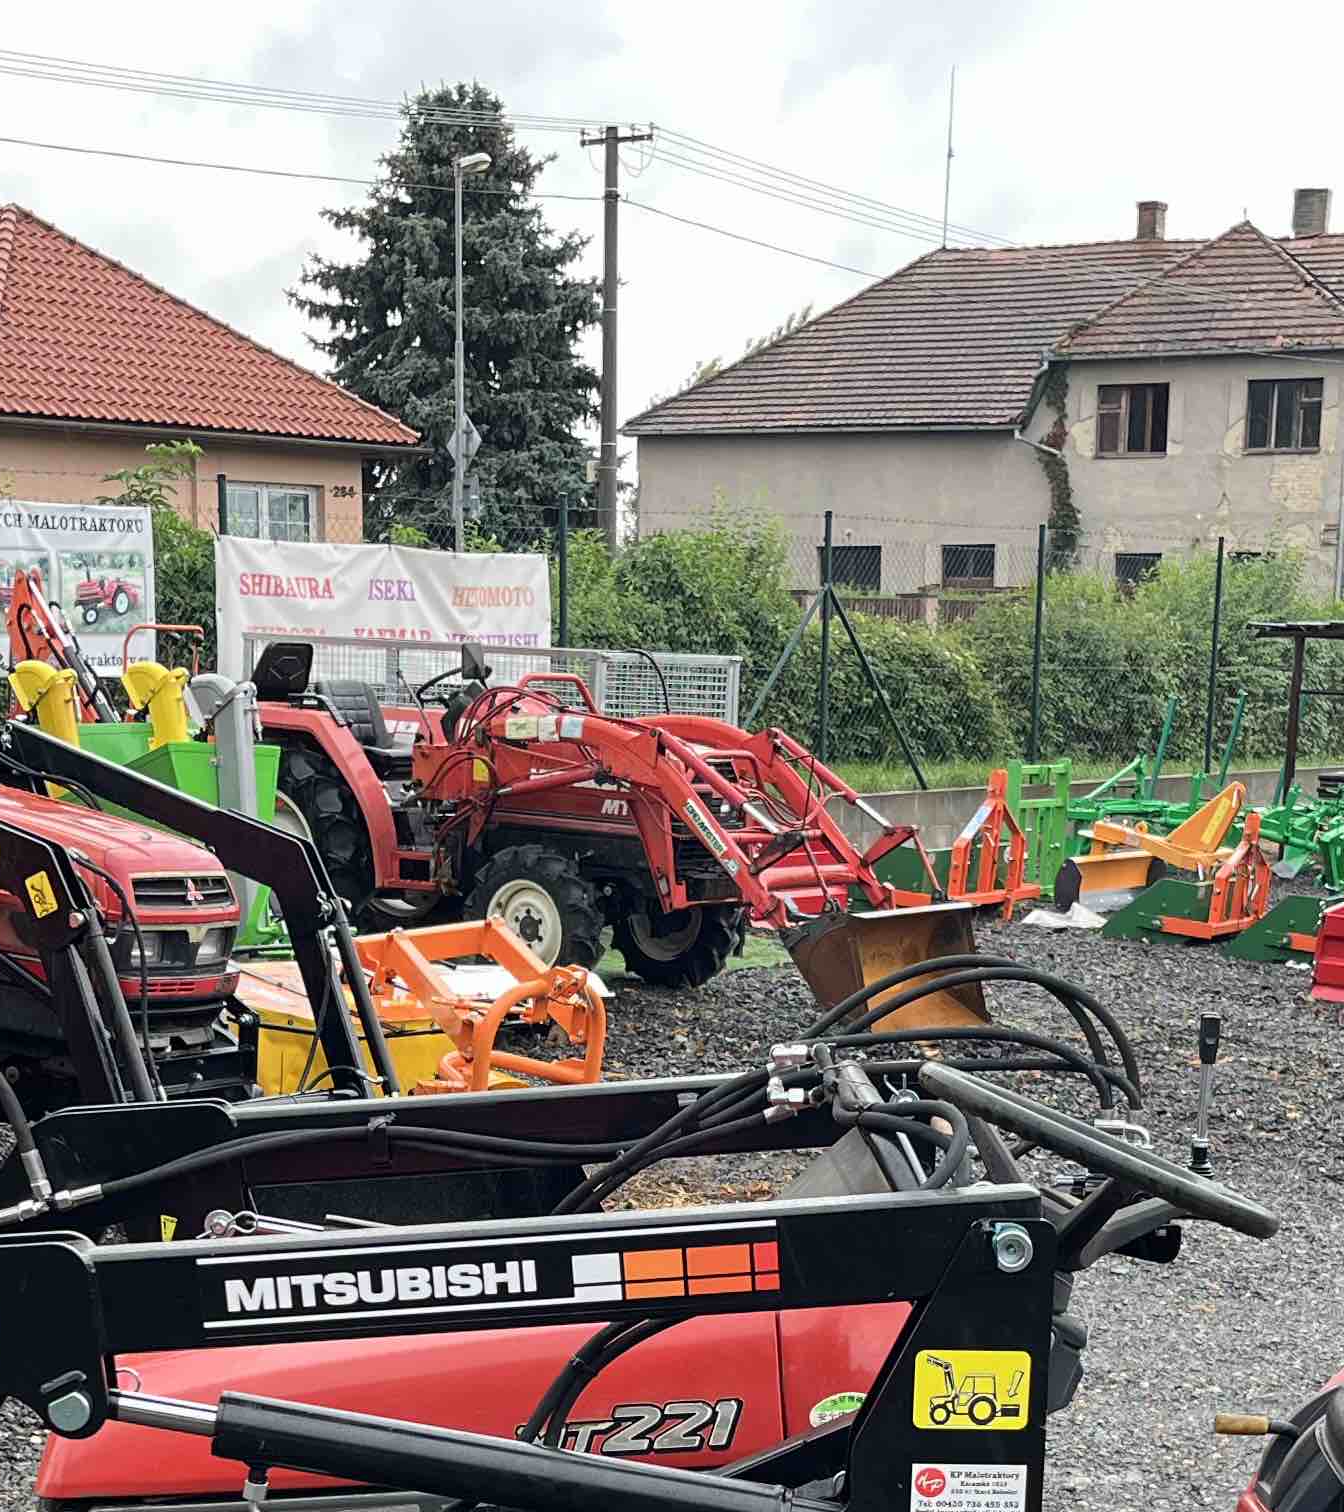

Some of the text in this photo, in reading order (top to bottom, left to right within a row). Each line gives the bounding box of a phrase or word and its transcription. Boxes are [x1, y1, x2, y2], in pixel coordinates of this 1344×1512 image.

[239, 572, 336, 600] SHIBAURA
[367, 578, 417, 601] ISEKI
[223, 1258, 538, 1313] MITSUBISHI
